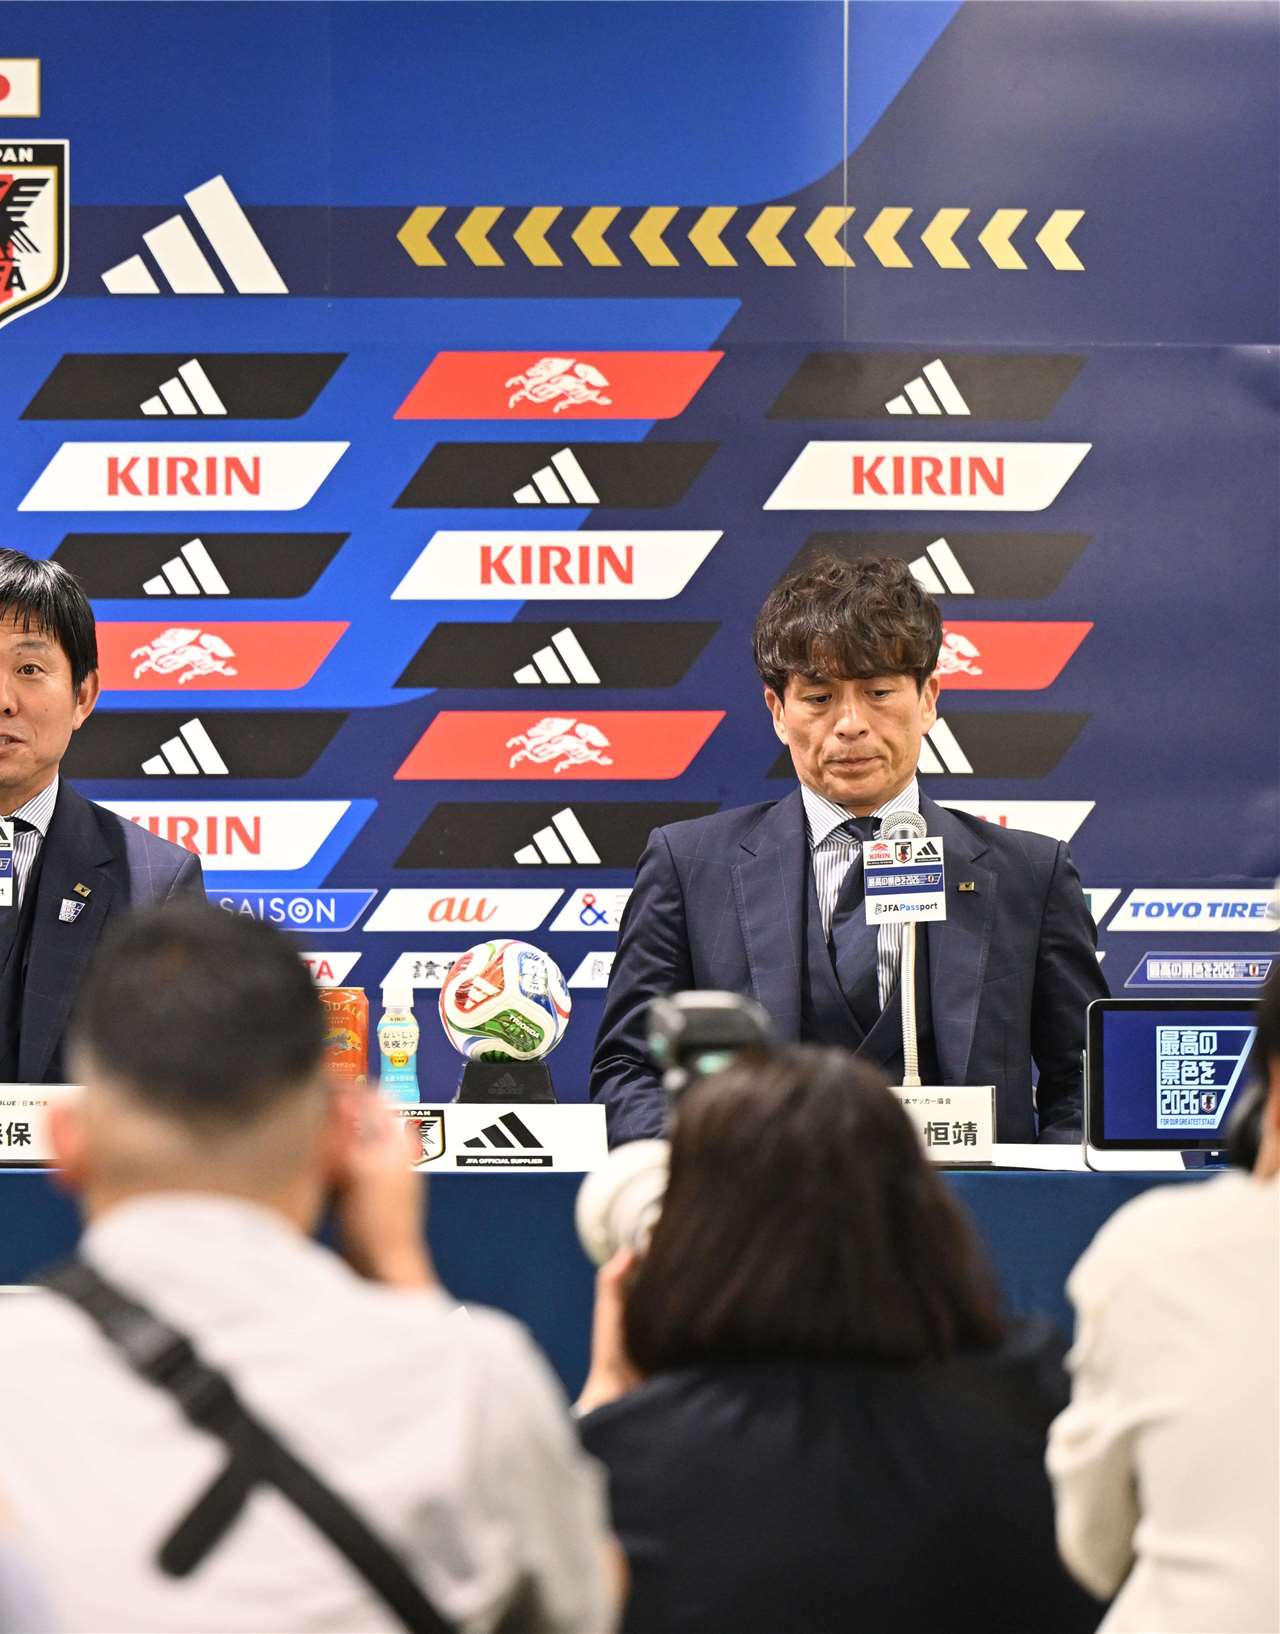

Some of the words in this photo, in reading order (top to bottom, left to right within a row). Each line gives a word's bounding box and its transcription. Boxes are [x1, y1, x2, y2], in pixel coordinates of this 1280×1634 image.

[108, 456, 260, 496] KIRIN
[853, 456, 1004, 496] KIRIN
[480, 545, 633, 585] KIRIN
[428, 897, 498, 923] au
[1130, 901, 1202, 918] TOYO
[508, 1014, 541, 1039] TRIONDA
[1161, 1030, 1218, 1056] 最高の
[1161, 1060, 1216, 1085] 景色を
[1161, 1089, 1200, 1115] 2026
[924, 1121, 978, 1147] 恒靖
